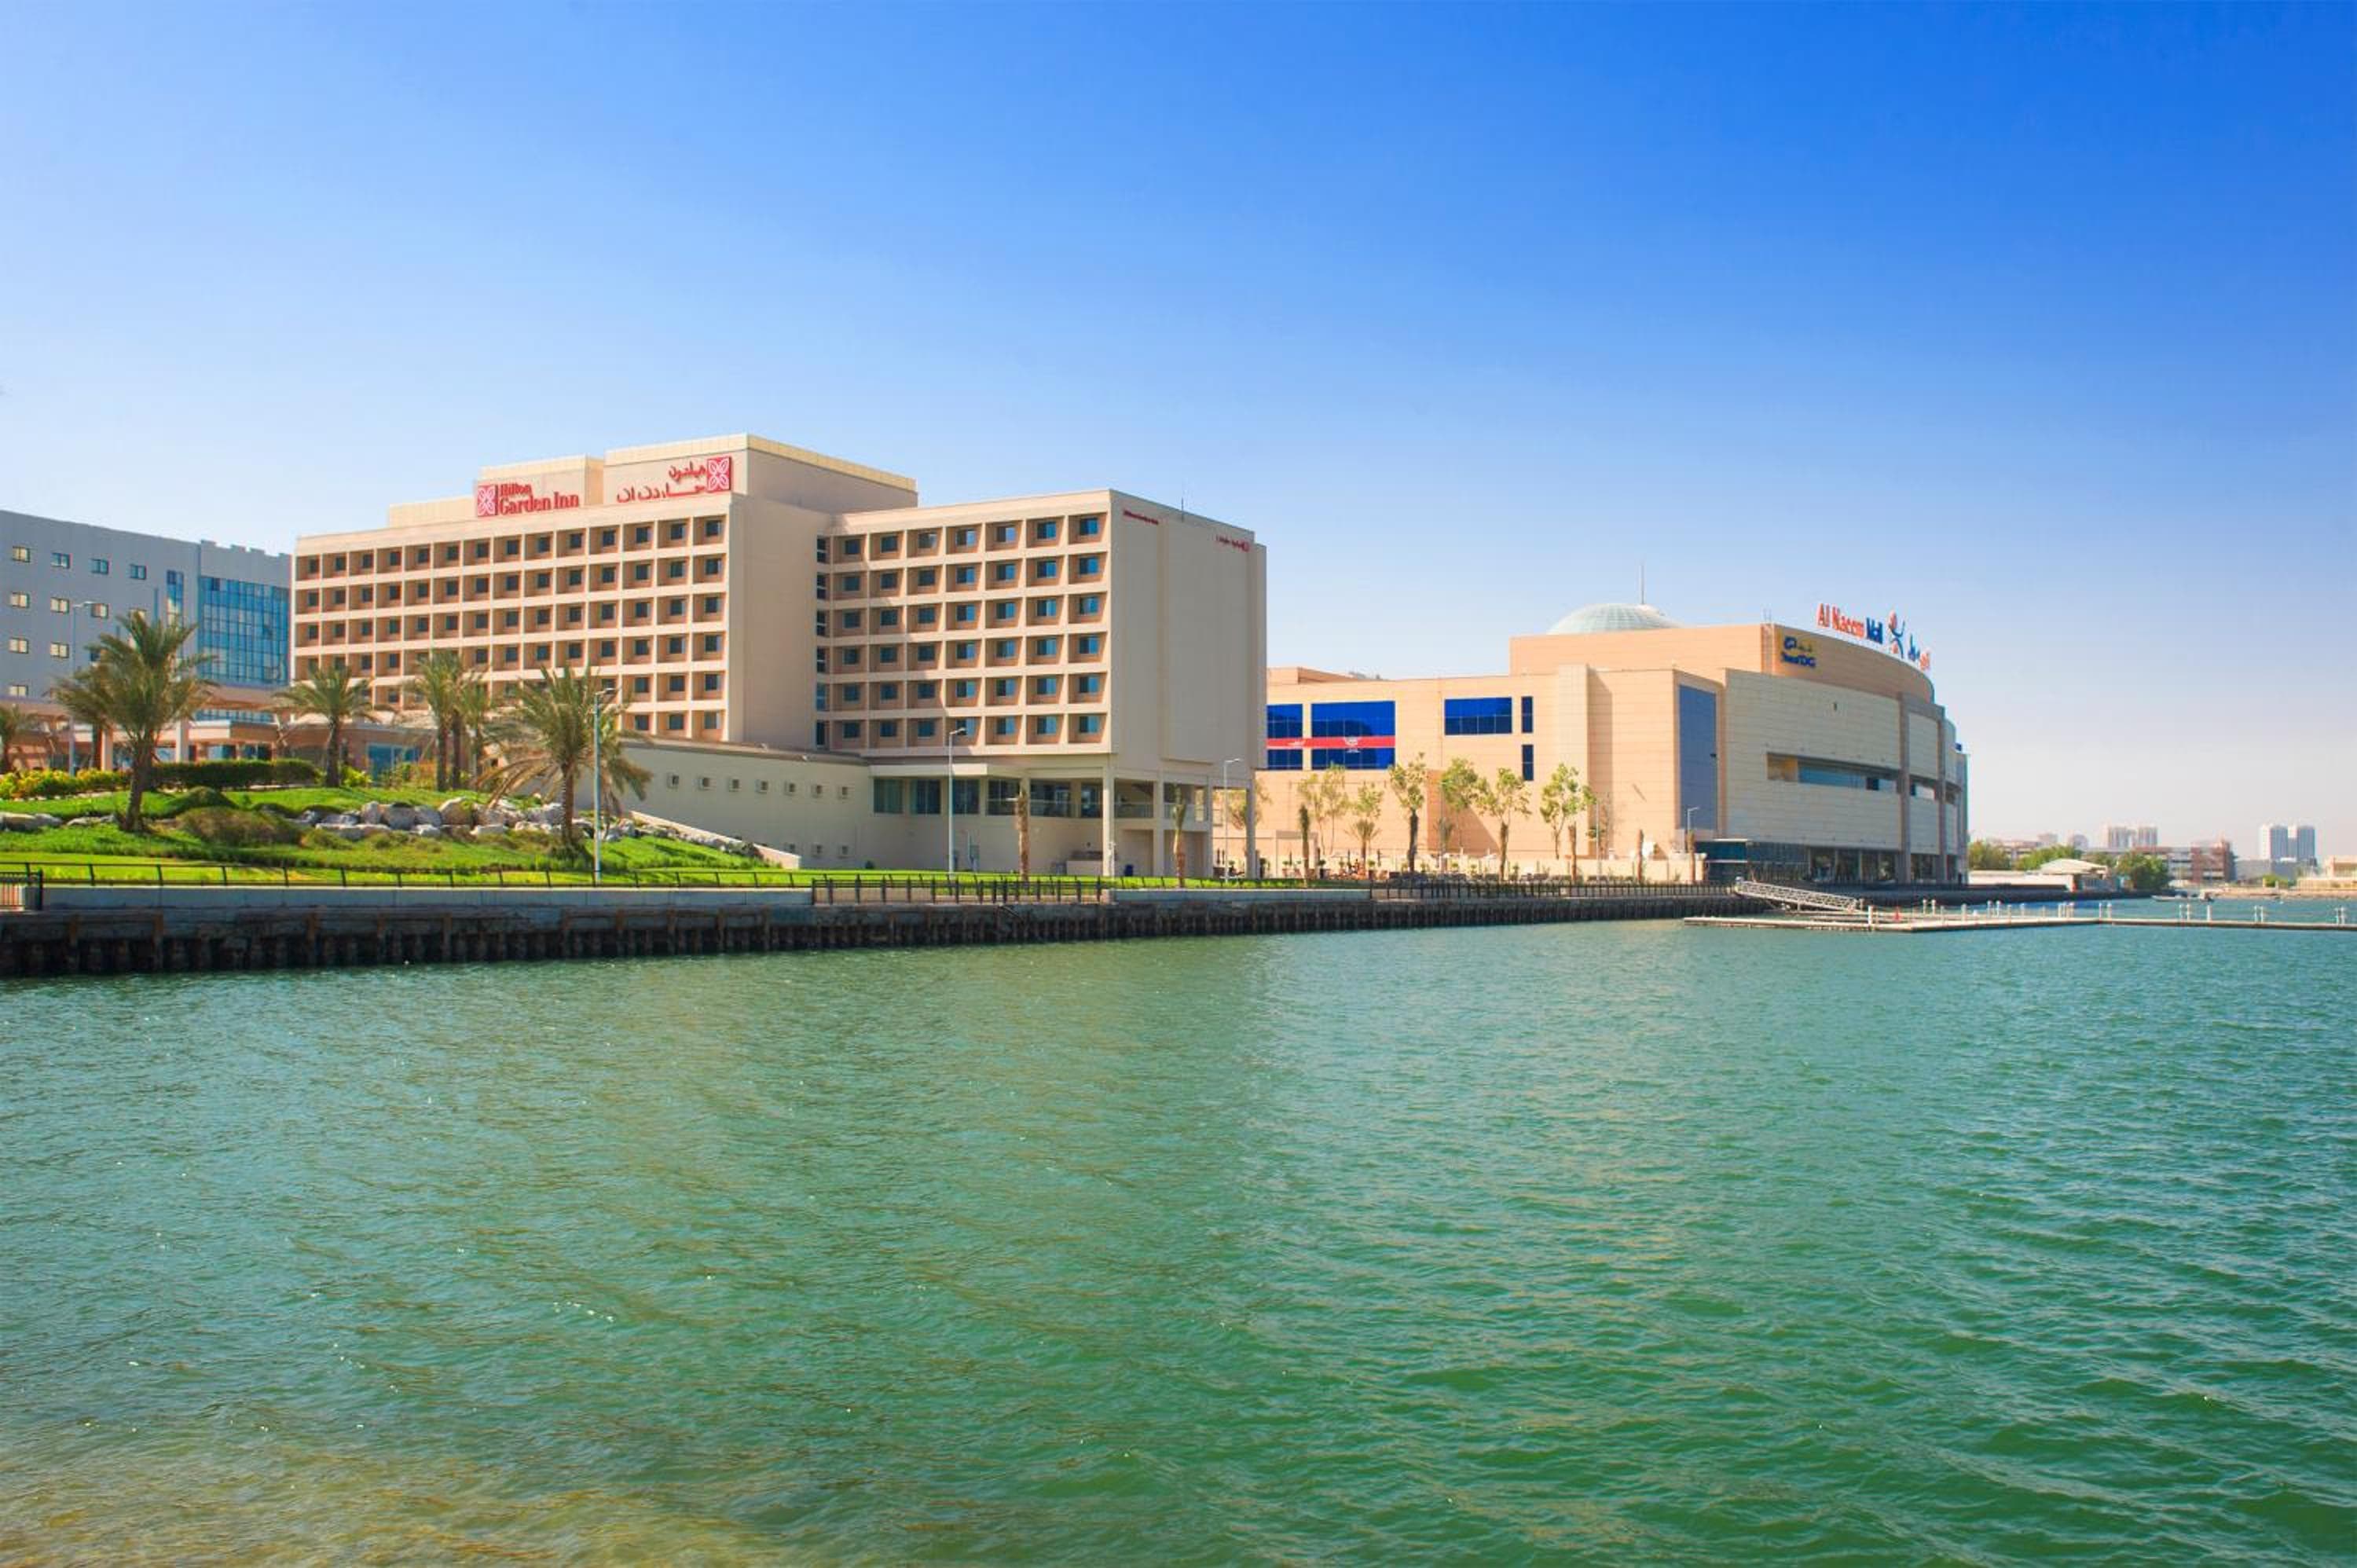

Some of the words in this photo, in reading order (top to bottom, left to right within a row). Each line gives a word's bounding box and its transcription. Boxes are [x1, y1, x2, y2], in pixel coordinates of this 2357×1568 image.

[500, 482, 532, 496] Hilton
[500, 495, 552, 515] Garden
[552, 491, 580, 510] Inn
